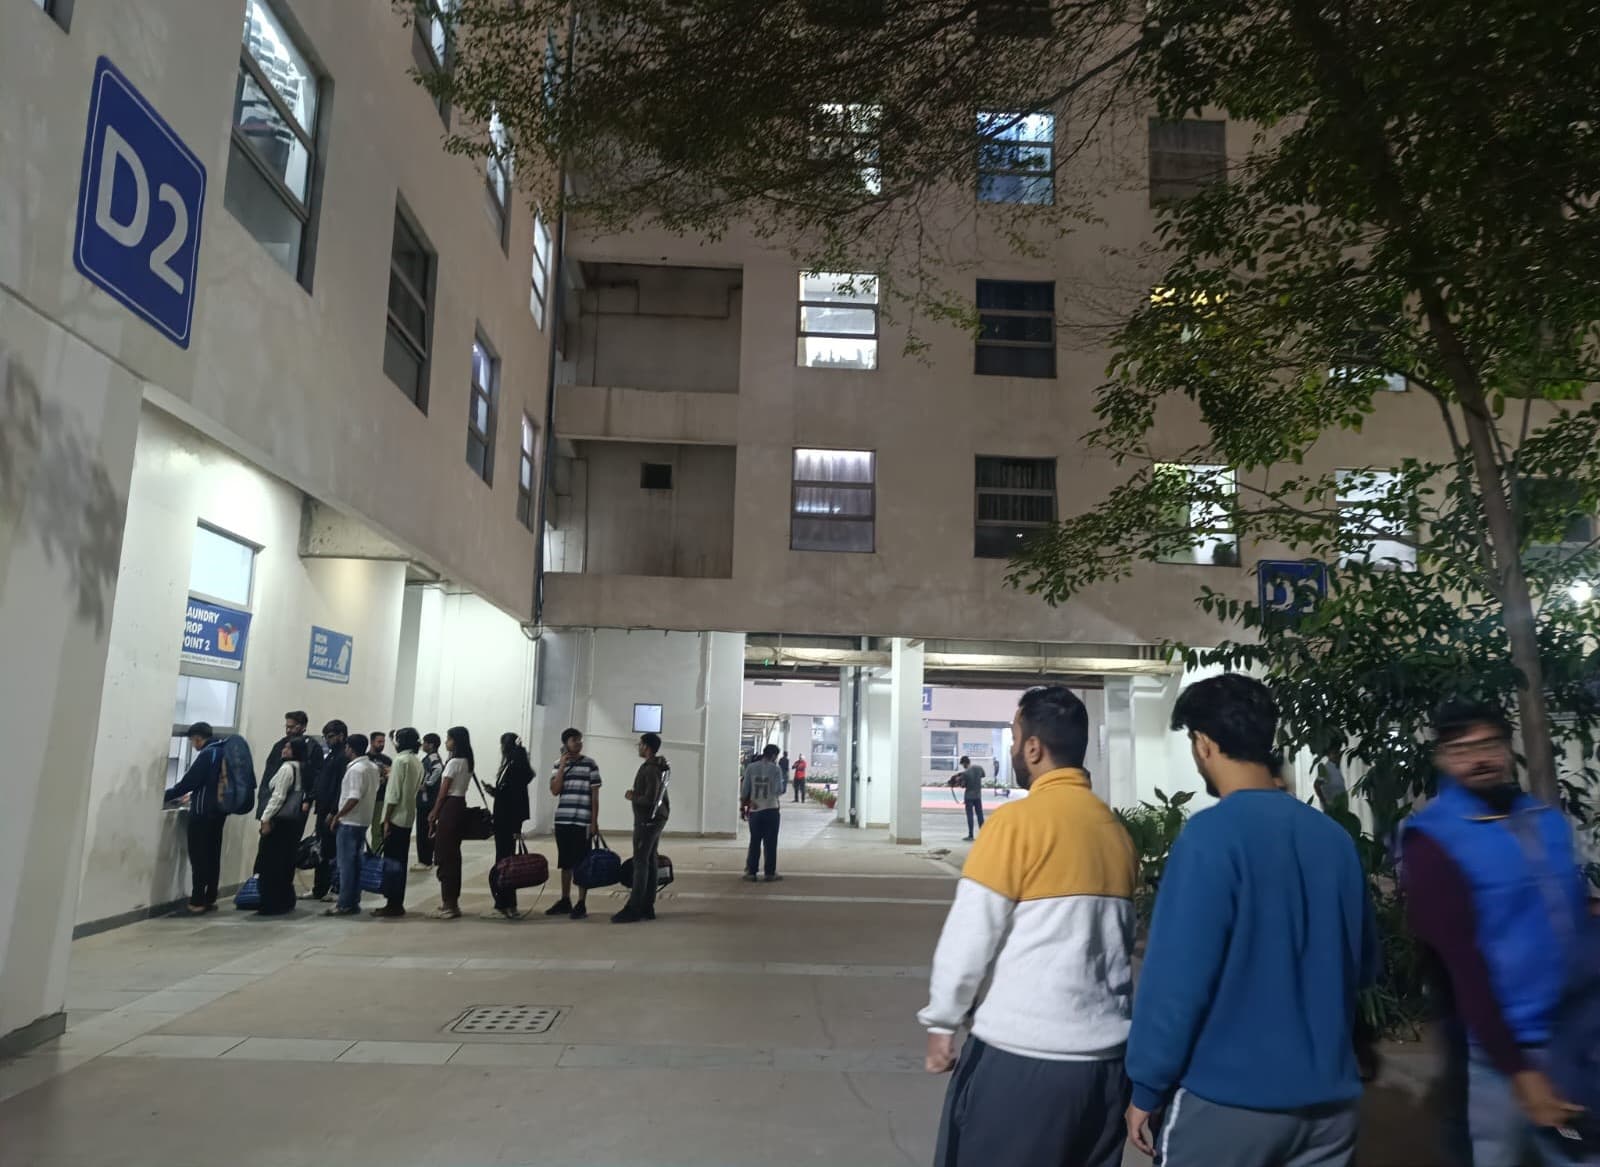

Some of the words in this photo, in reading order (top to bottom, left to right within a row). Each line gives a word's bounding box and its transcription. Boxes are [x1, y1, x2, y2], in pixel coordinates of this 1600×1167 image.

[96, 125, 185, 295] D2
[186, 606, 220, 624] AUNDRY
[185, 621, 203, 635] ROP
[184, 636, 204, 650] OINT
[204, 639, 211, 651] 2
[922, 692, 930, 705] 1
